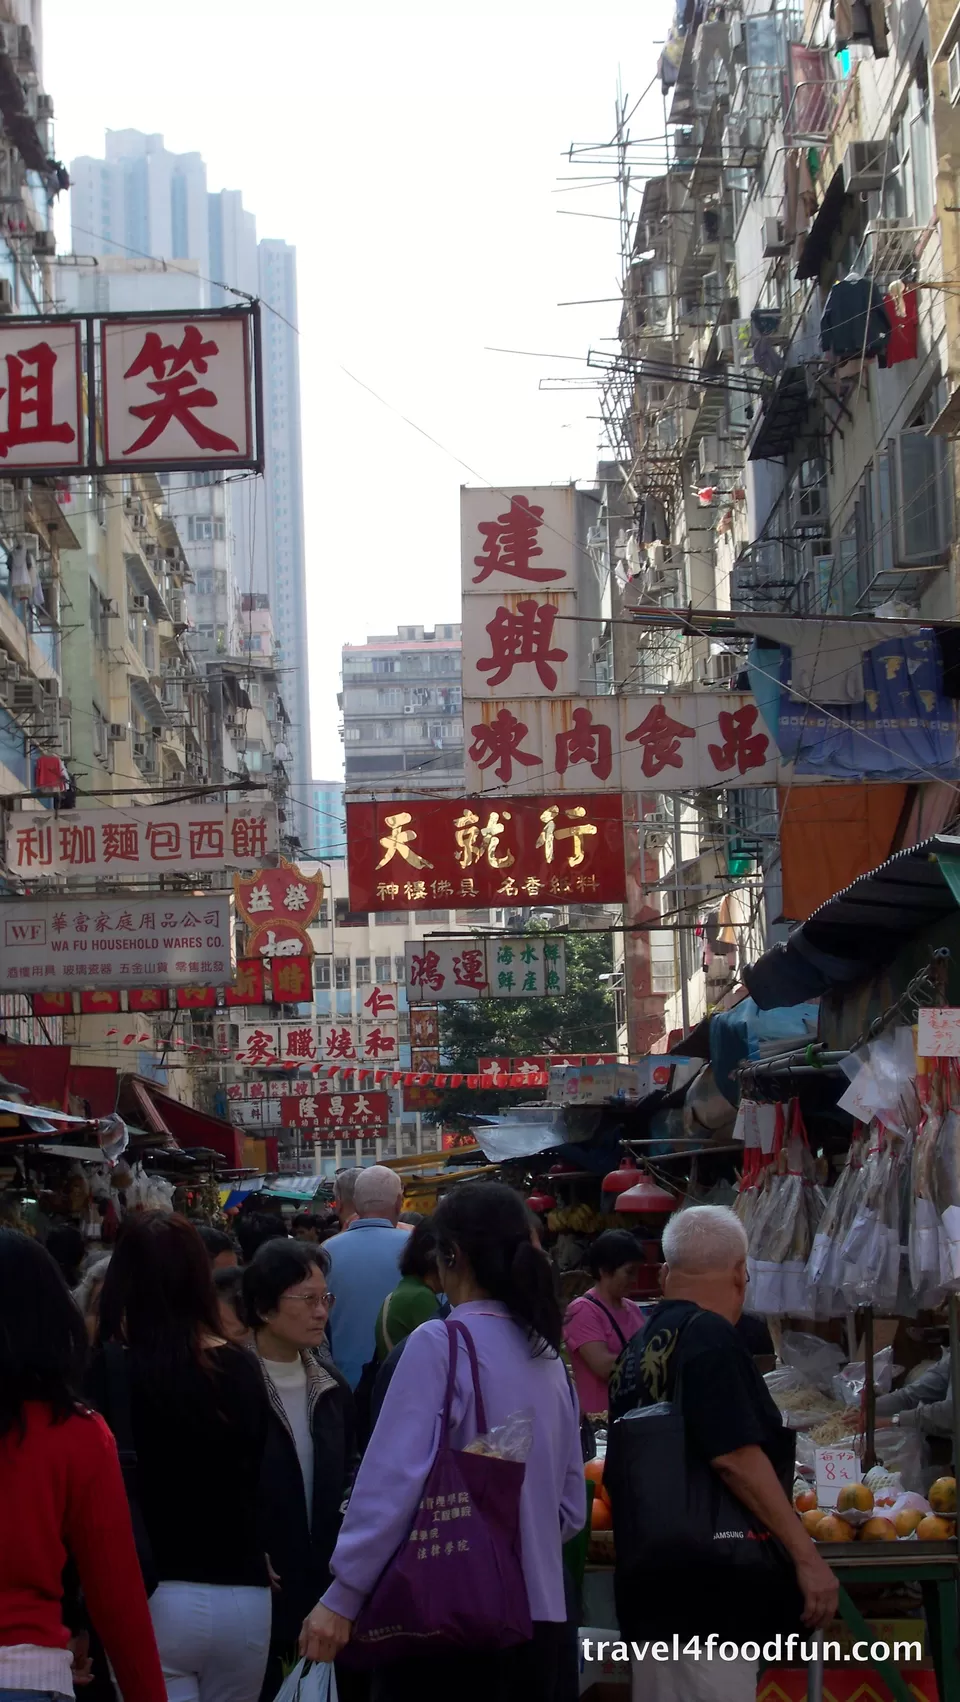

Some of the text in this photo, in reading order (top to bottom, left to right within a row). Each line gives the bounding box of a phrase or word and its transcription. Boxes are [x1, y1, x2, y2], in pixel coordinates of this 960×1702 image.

[468, 703, 769, 782] 凍肉食品
[16, 817, 268, 866] 利珈麵包西餅
[375, 804, 598, 870] 天就行
[11, 924, 42, 941] WF
[52, 910, 221, 934] 華富家庭用品公司
[52, 935, 226, 952] WA FU HOUSEHOLD WARES CO.
[63, 962, 112, 977] 玻璃瓷器
[119, 961, 169, 975] 五金山貨
[175, 960, 225, 973] 零售批發
[410, 949, 490, 991] 鴻運
